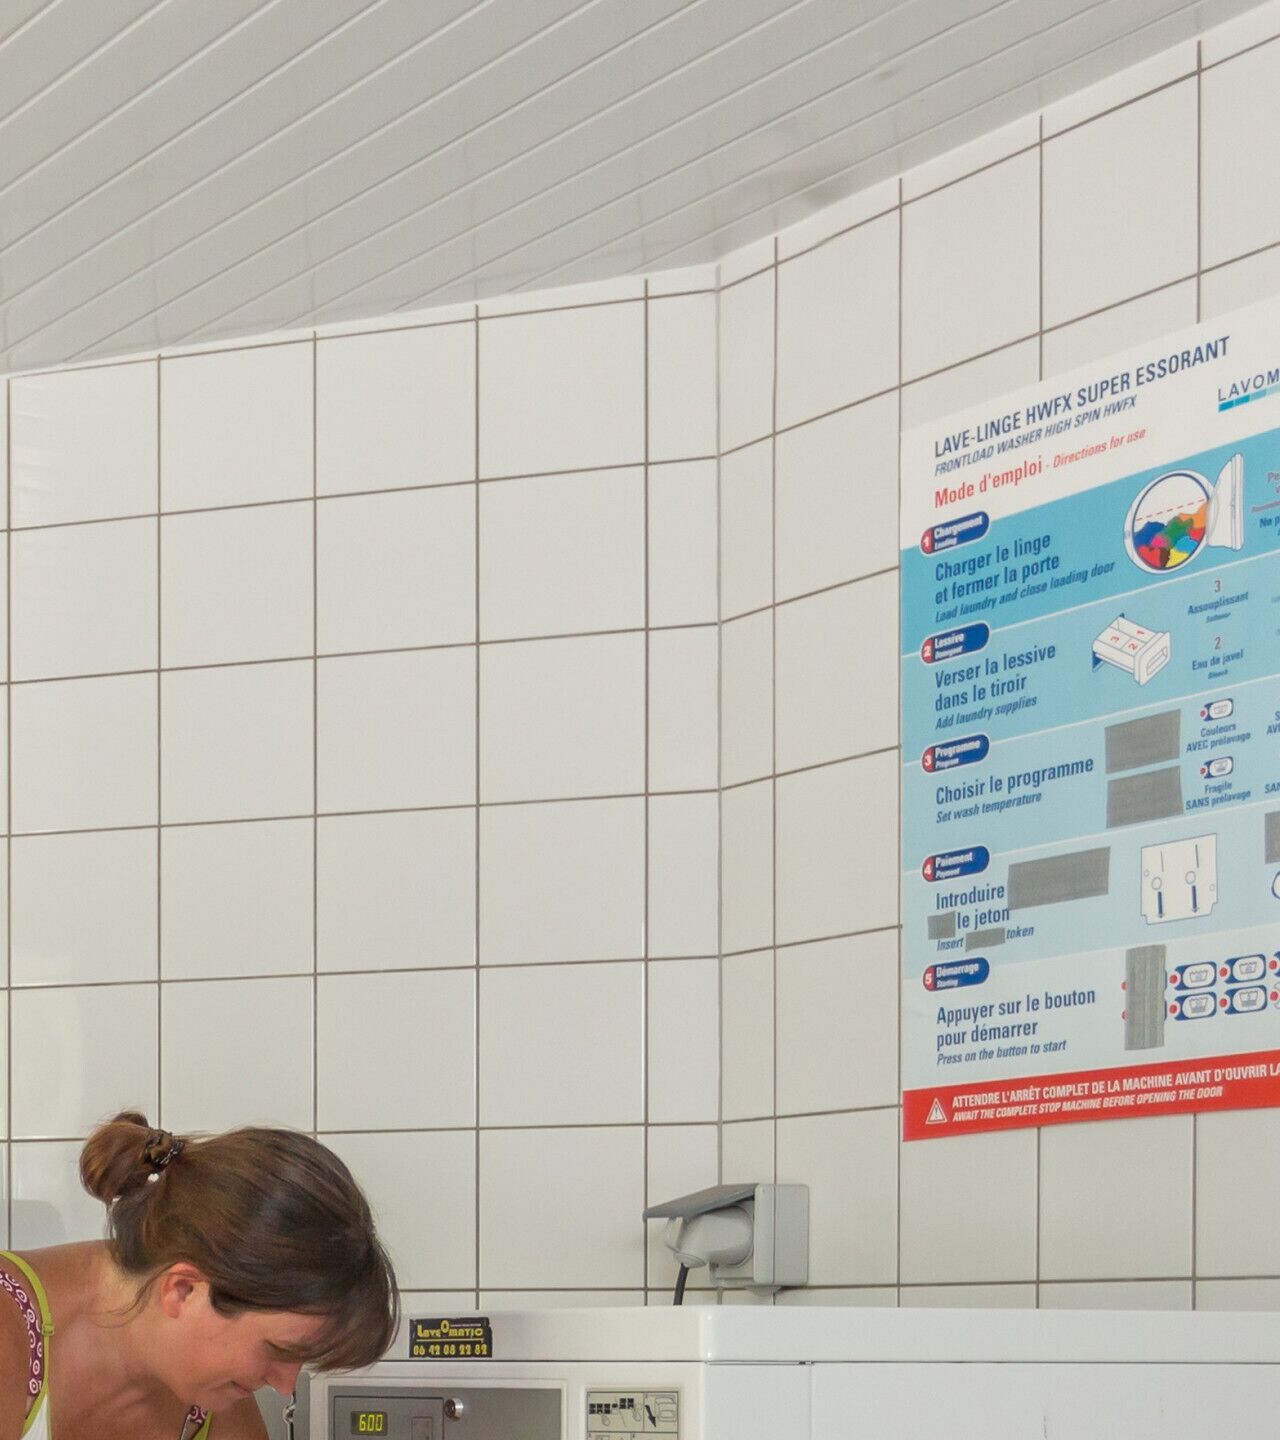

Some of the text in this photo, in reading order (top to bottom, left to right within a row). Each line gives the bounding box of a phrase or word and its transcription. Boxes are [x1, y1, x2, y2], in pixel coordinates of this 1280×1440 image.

[935, 335, 1229, 458] LAVE-LINGE HWFX SUPER ESSORANT
[934, 394, 1137, 476] FRONTLOAD WASHER HIGH SPIN HWFX
[935, 428, 1146, 508] Mode d'emploi Directions for use
[935, 534, 1051, 582] Charger le linge
[935, 555, 1060, 605] et fermer la porte
[935, 561, 1115, 623] Load laundry and close loading door
[935, 644, 1056, 688] Verser la lessive
[935, 673, 1027, 712] dans le tiroir
[935, 695, 1038, 730] Add laundry supplies
[935, 758, 1094, 805] Choisir le programme
[936, 792, 1042, 824] Set wash temperature
[936, 883, 1005, 910] Introduire
[957, 902, 1010, 931] le jeton
[936, 925, 1034, 951] Insert token
[936, 989, 1095, 1028] Appuyer sur le bouton
[936, 1021, 1038, 1052] pour démarrer
[936, 1039, 1067, 1065] Press on the button to start
[952, 1091, 1000, 1108] ATTENDRE
[1001, 1085, 1041, 1103] L'ARRÊT
[1042, 1082, 1090, 1099] COMPLET
[1091, 1081, 1105, 1094] DE
[1107, 1079, 1121, 1093] LA
[1122, 1074, 1172, 1091] MACHINE
[1174, 1069, 1212, 1085] AVANT
[1214, 1064, 1267, 1082] D'OUVRIR
[980, 1108, 995, 1119] THE
[995, 1104, 1038, 1118] COMPLETE
[1038, 1101, 1061, 1114] STOP
[1061, 1097, 1101, 1111] MACHINE
[1102, 1094, 1135, 1108] BEFORE
[1136, 1090, 1177, 1104] OPENING
[1178, 1088, 1196, 1100] THE
[1196, 1085, 1223, 1099] DOOR
[413, 1345, 425, 1356] 06
[359, 1414, 384, 1432] 600
